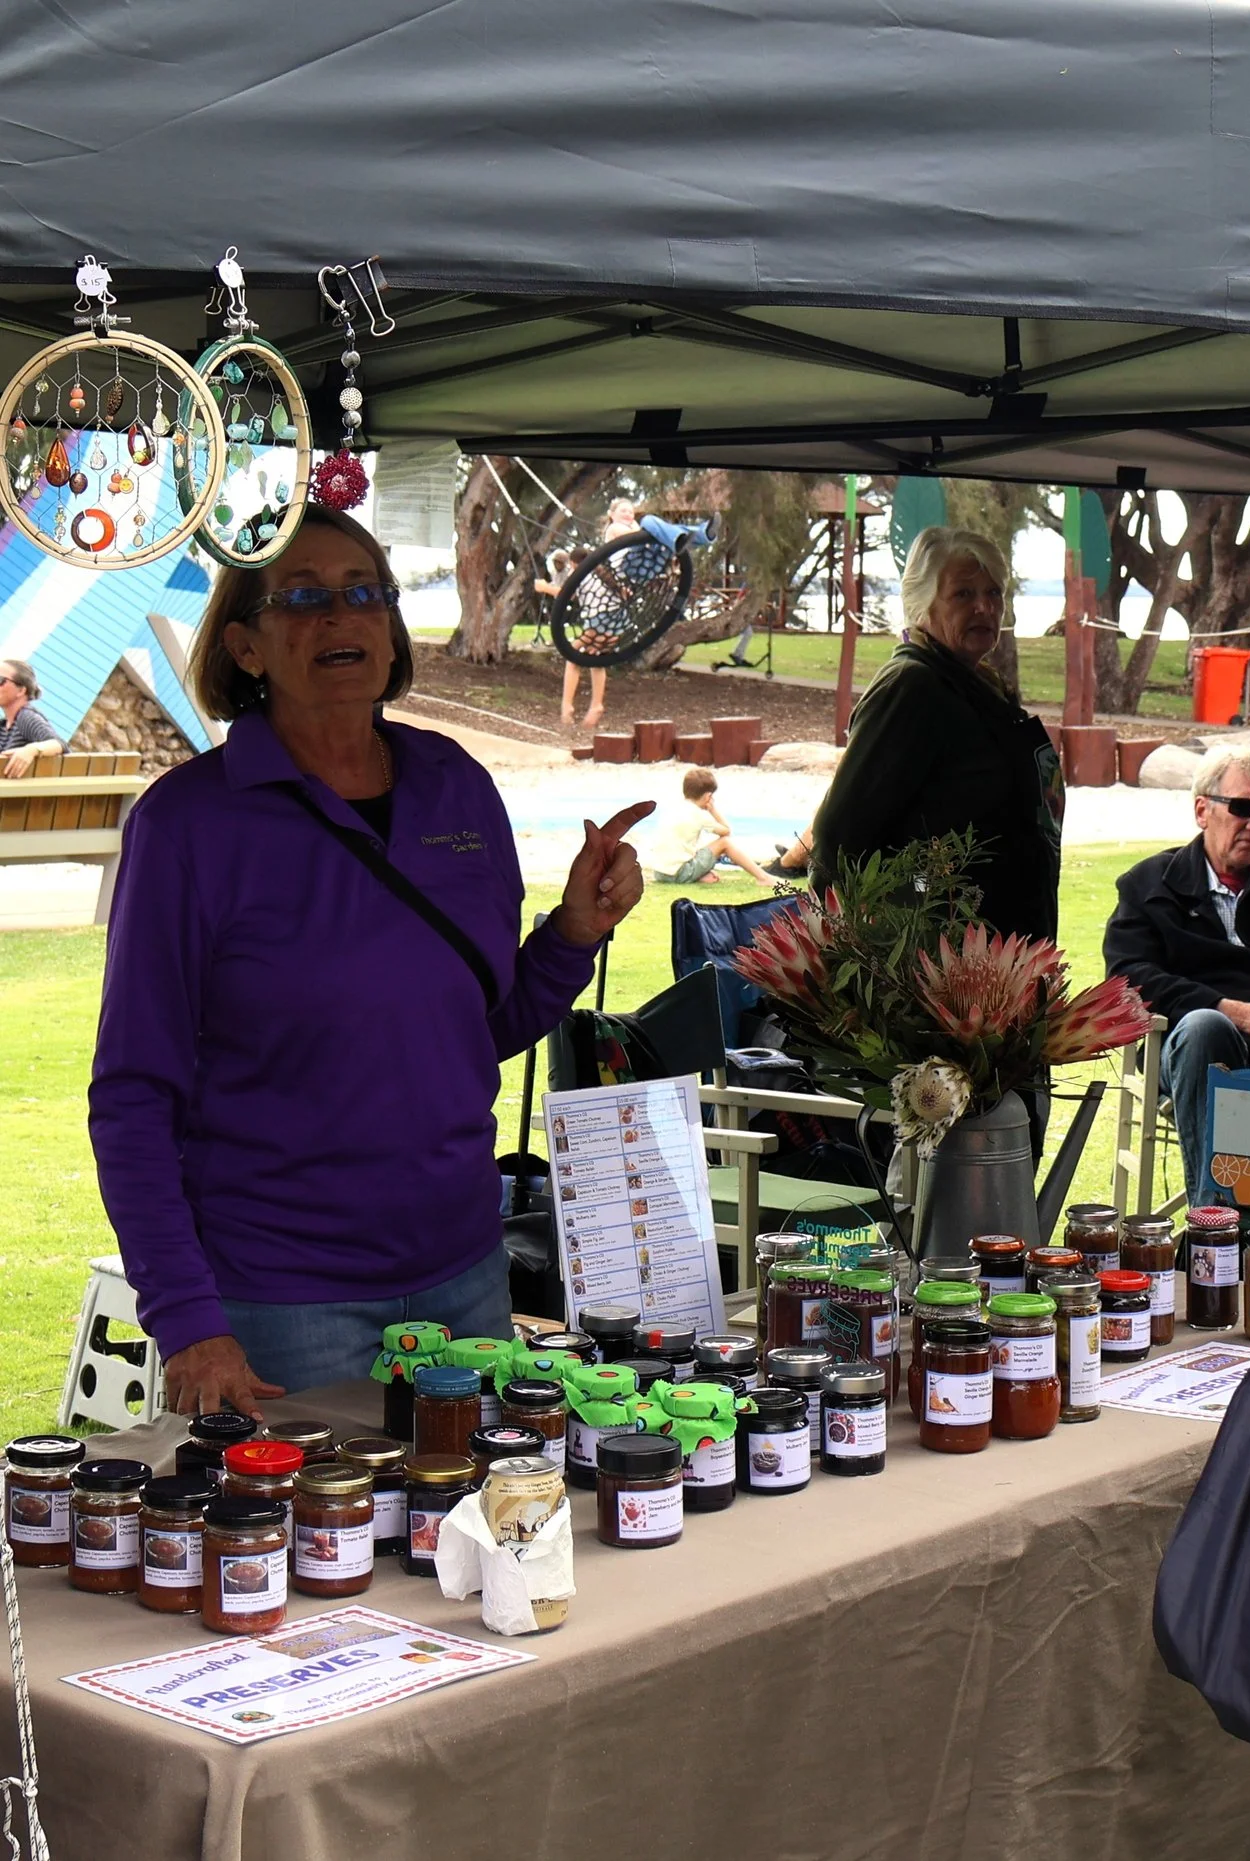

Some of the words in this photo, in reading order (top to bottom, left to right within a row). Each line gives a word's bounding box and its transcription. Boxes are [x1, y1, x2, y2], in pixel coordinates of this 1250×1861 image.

[1028, 1350, 1044, 1358] Orange
[374, 1499, 394, 1507] ommo's
[648, 1497, 671, 1505] Thommo's
[648, 1503, 671, 1512] Strawberry
[340, 1535, 359, 1543] Tomato
[145, 1652, 251, 1696] Handcrafted
[180, 1648, 380, 1710] PRESERVES
[282, 1699, 333, 1716] Thommo's
[334, 1681, 389, 1702] Community
[390, 1666, 426, 1682] Garden
[323, 1681, 368, 1700] proceeds
